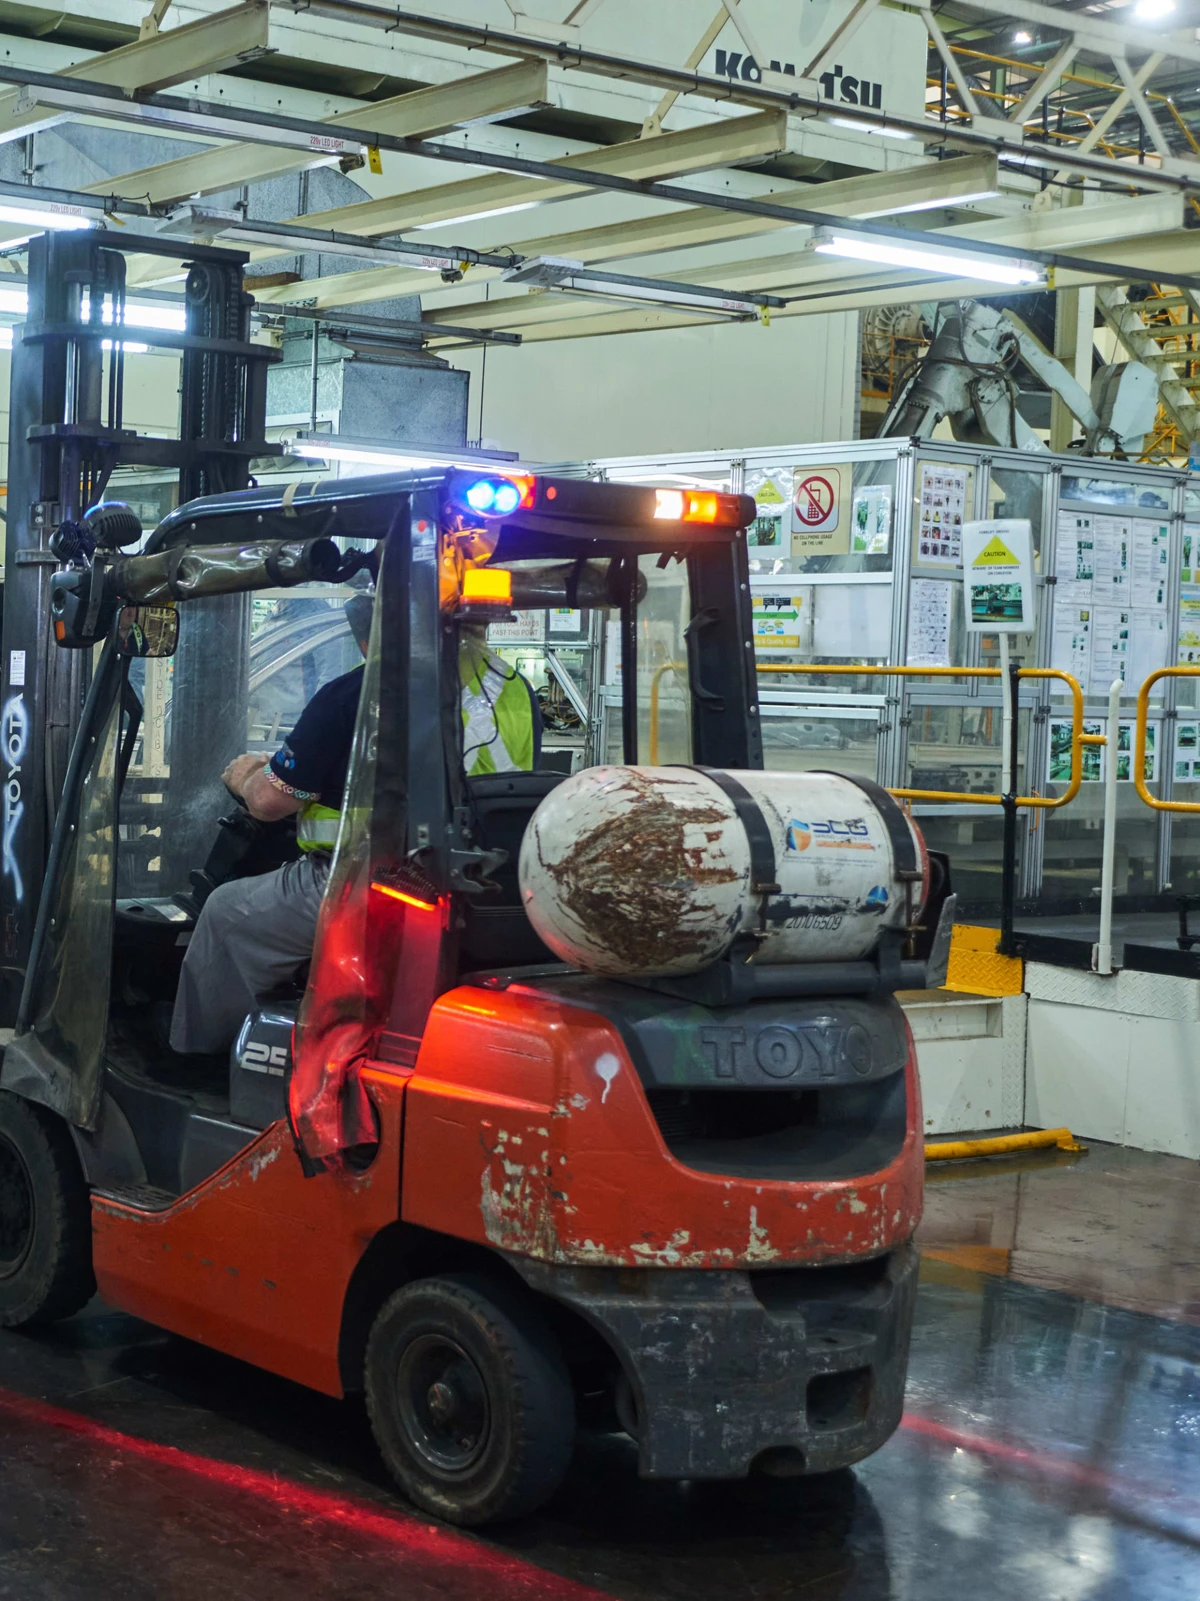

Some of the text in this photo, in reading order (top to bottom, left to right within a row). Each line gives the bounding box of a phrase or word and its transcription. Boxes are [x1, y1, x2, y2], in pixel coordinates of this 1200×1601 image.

[716, 49, 882, 109] KOMTSU
[321, 137, 331, 147] LED
[331, 138, 345, 149] LIGHT
[7, 692, 23, 822] TOYOTA
[240, 1041, 288, 1077] 25
